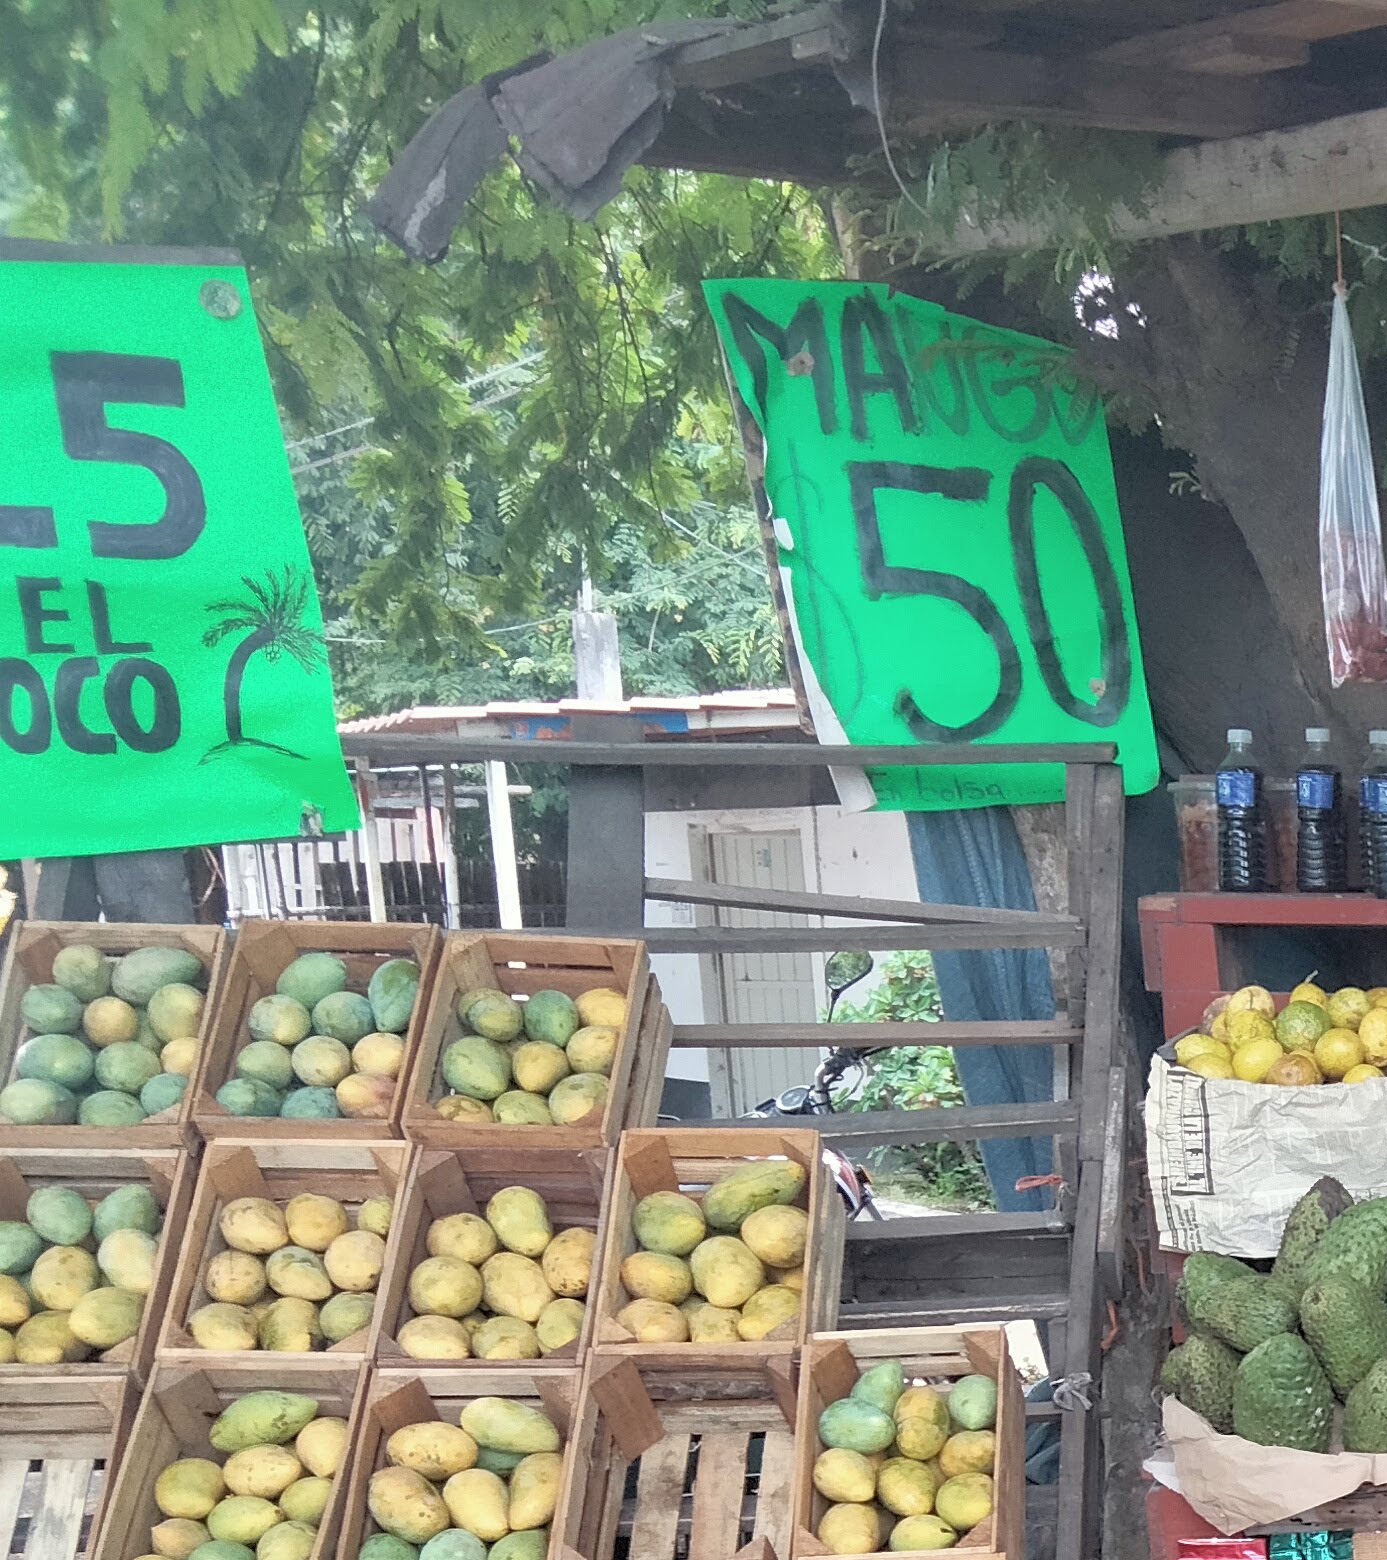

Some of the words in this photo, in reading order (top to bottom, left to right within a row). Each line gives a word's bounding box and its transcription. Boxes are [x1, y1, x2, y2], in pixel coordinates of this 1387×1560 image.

[0, 350, 207, 560] 5
[16, 577, 153, 655] EL
[915, 766, 1008, 802] bolsa
